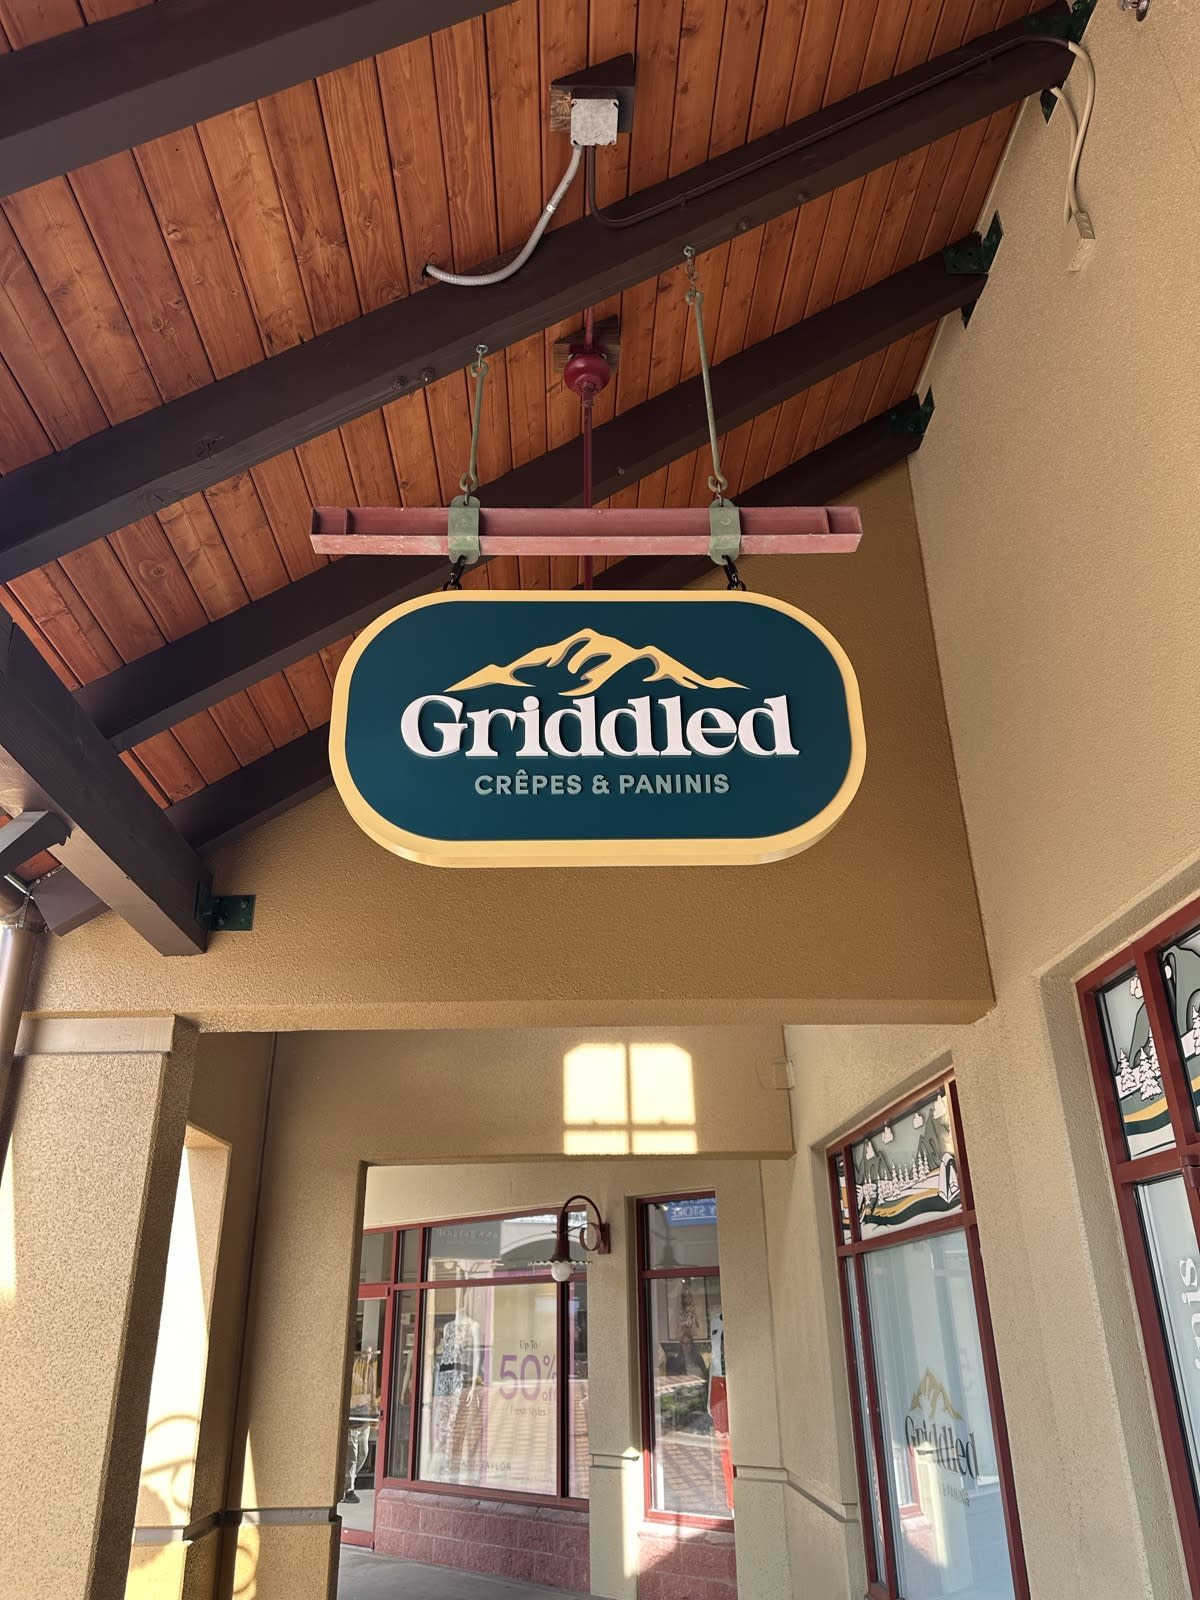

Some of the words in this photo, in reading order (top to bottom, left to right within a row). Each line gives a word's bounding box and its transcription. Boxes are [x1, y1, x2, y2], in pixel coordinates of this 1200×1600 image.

[401, 694, 800, 758] Griddled
[474, 768, 582, 796] CRÊPES
[591, 774, 610, 796] &
[619, 773, 730, 795] PANINIS
[499, 1354, 557, 1401] 50%
[904, 1415, 980, 1480] Griddled
